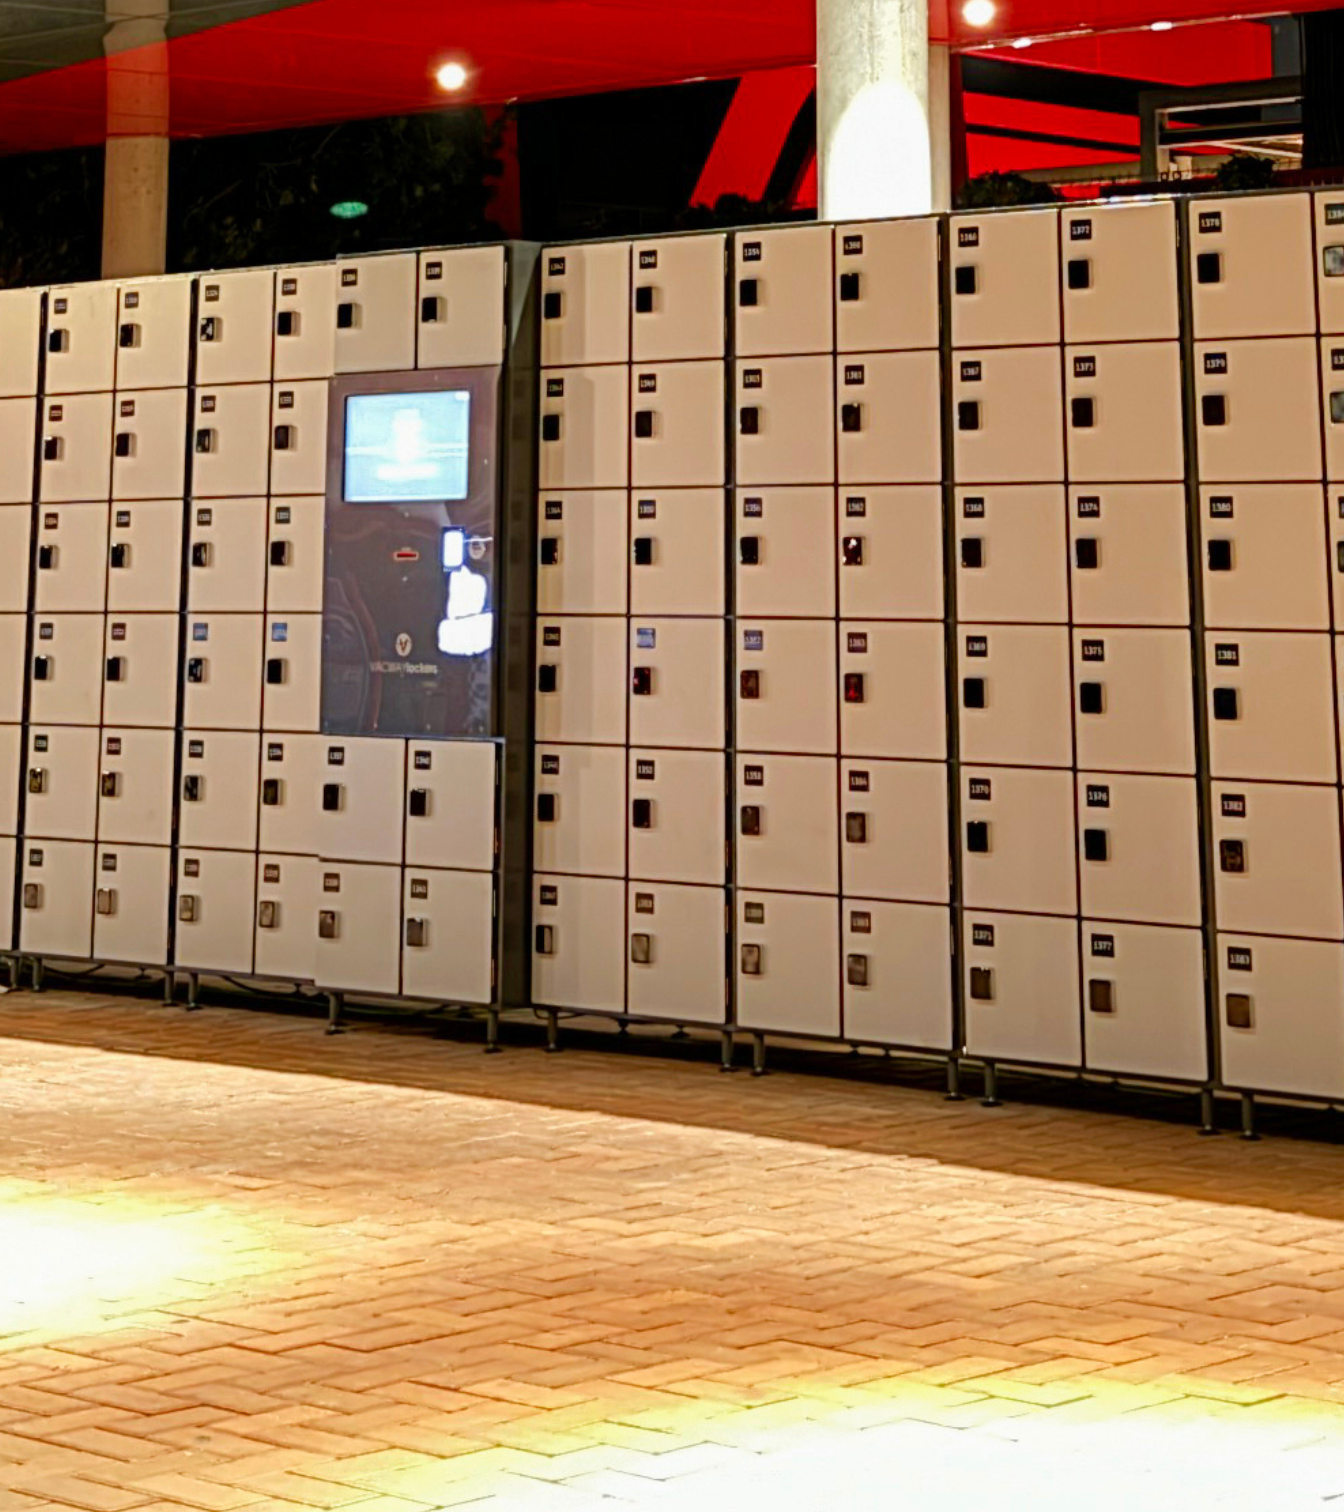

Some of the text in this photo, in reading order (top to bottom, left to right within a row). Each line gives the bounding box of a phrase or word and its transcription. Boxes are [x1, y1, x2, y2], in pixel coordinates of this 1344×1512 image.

[1201, 218, 1220, 228] 1378
[1206, 358, 1226, 369] 1379
[1212, 502, 1232, 512] 1380
[1217, 650, 1237, 660] 1381
